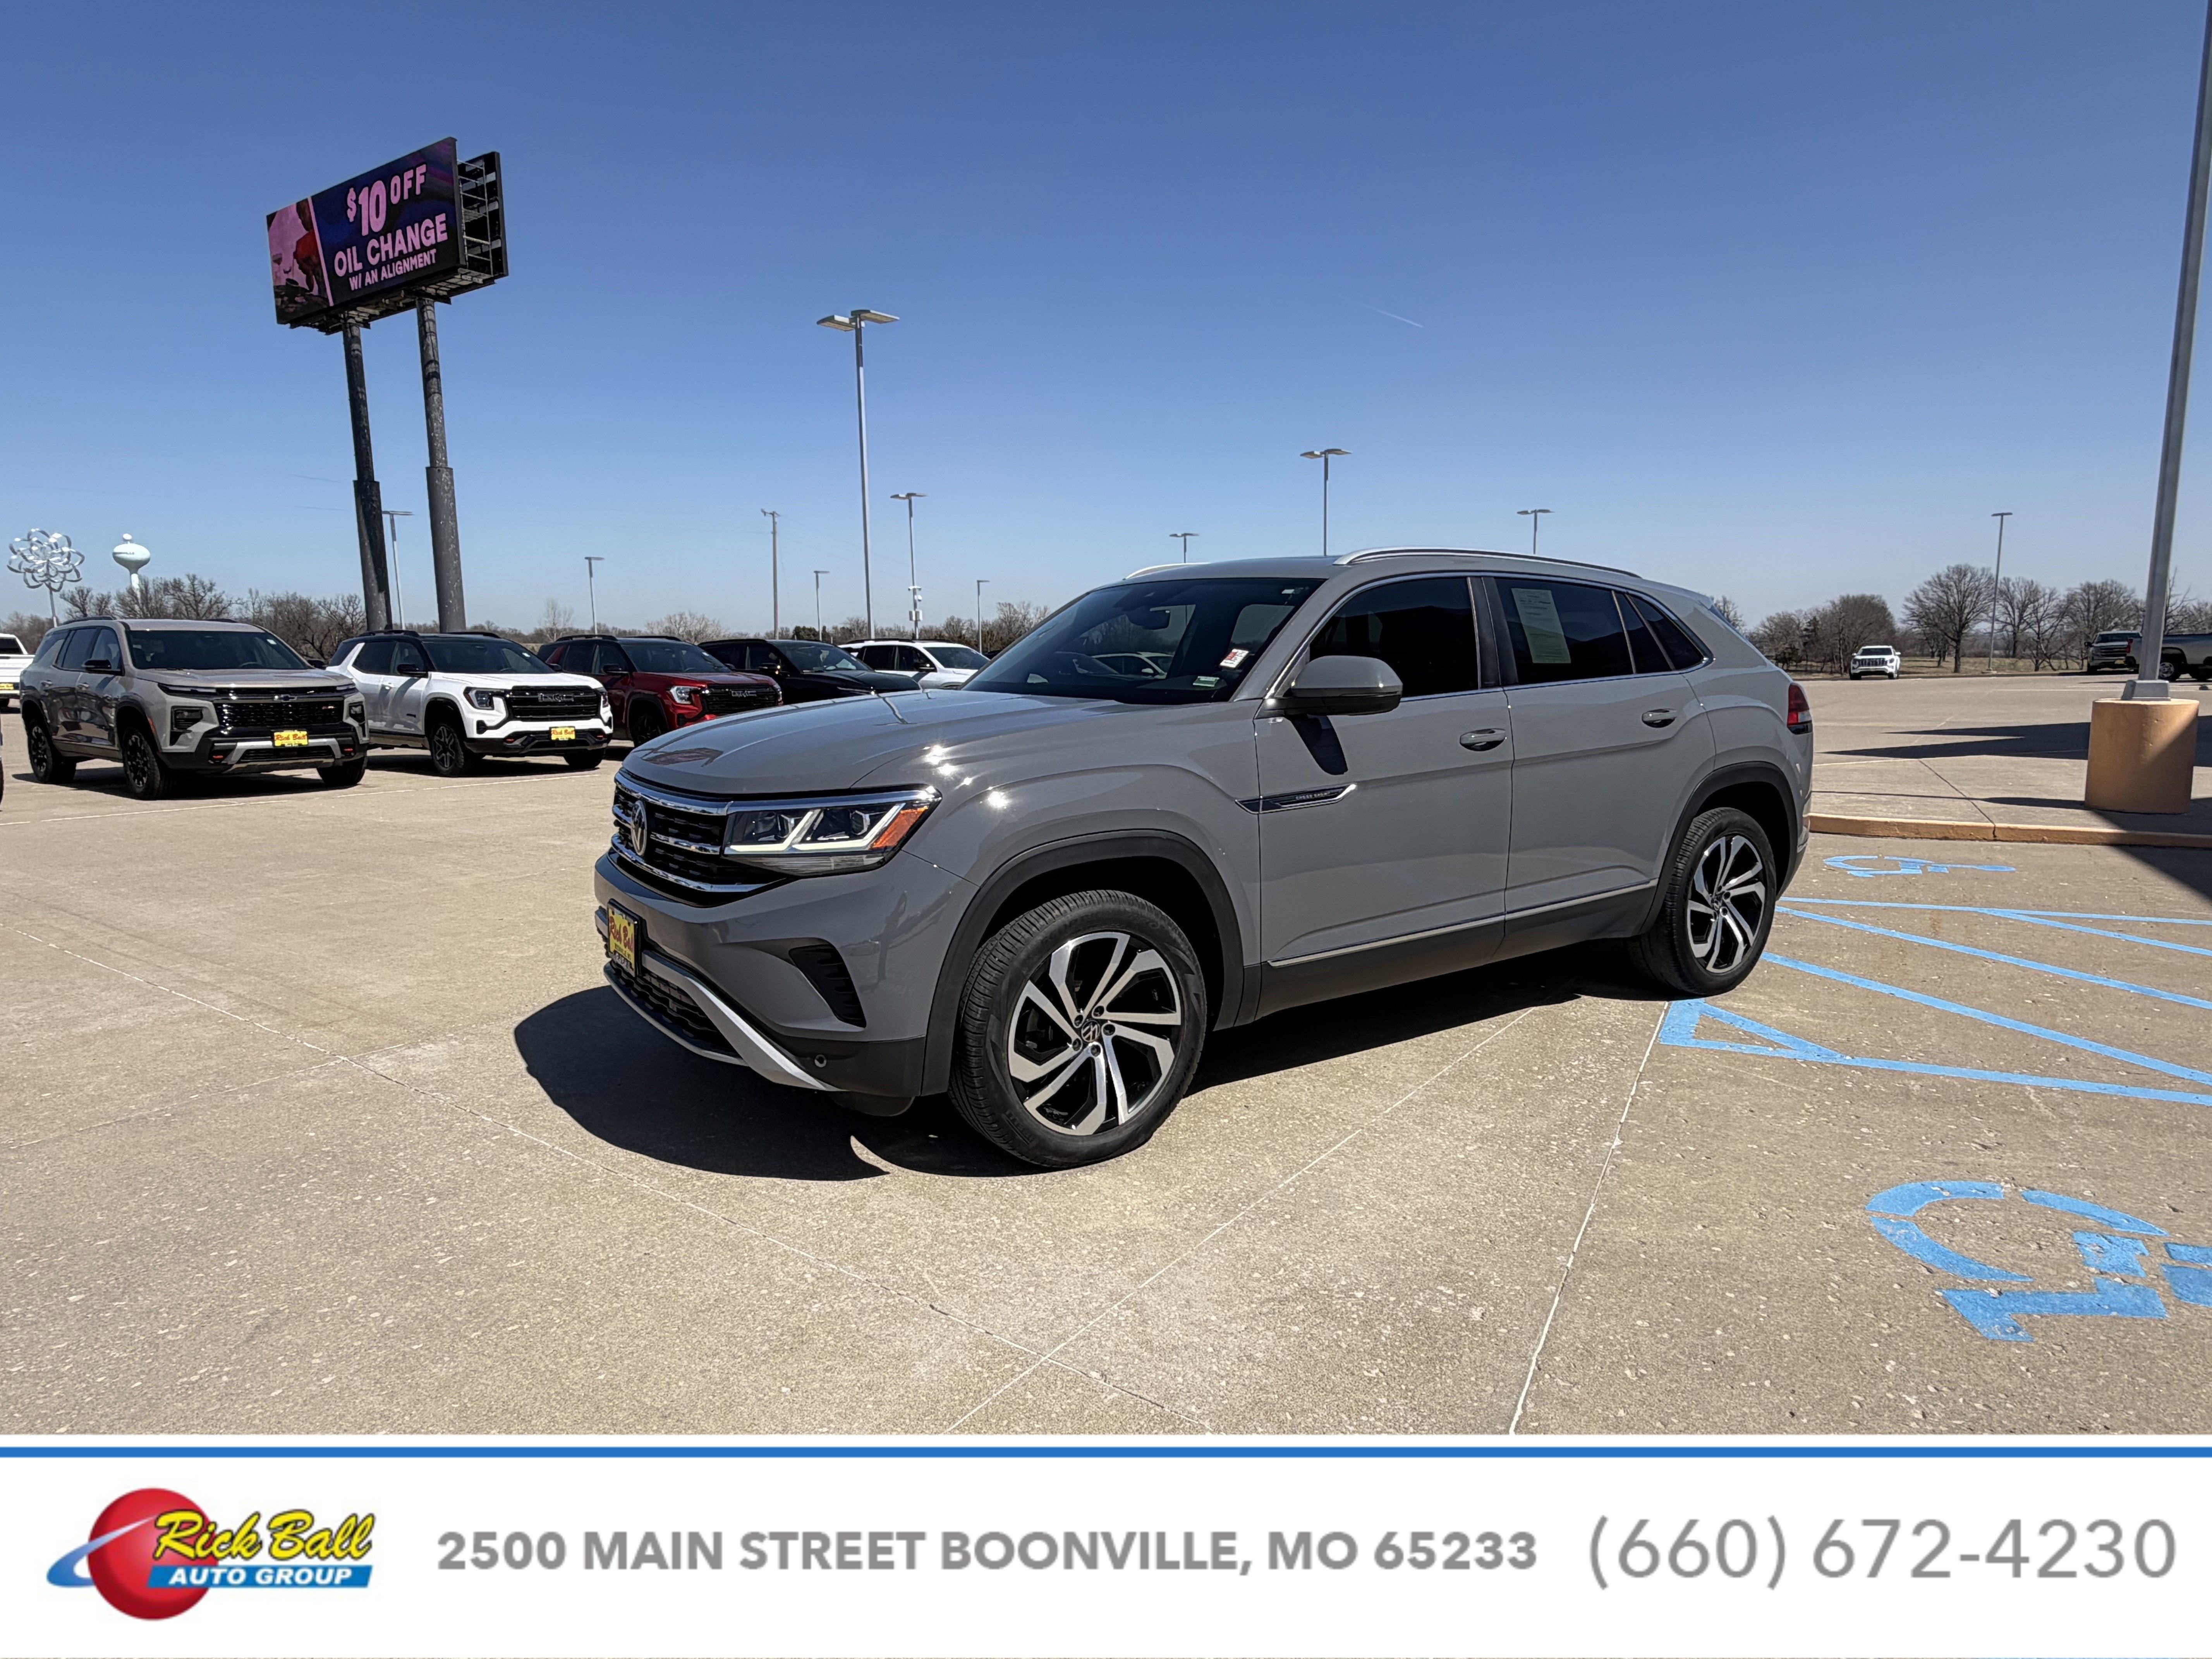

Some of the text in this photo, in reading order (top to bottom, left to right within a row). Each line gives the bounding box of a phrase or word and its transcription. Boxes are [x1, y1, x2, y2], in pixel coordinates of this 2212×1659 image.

[347, 164, 426, 236] $10 OFF
[334, 213, 448, 277] OIL CHANGE
[349, 249, 436, 291] W/ AN ALIGNMENT
